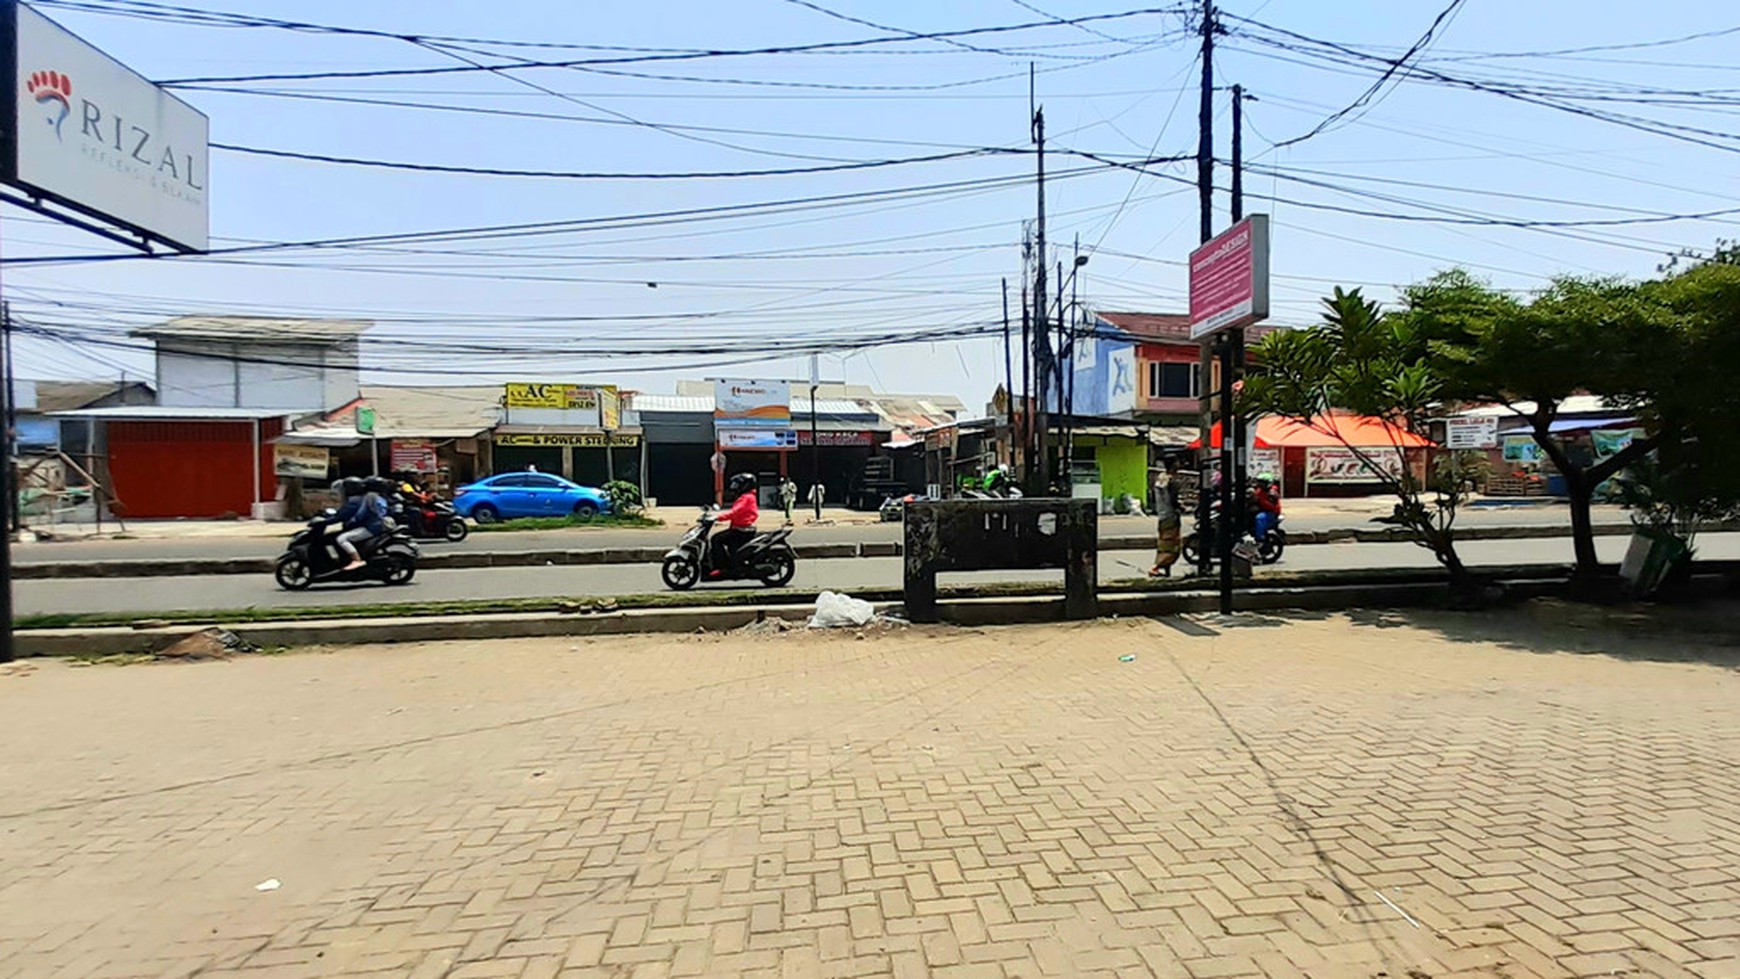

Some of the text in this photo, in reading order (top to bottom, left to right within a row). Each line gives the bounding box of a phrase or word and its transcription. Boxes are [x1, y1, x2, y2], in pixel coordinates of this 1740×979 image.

[81, 98, 202, 191] RIZAL
[525, 384, 553, 399] AC
[501, 435, 516, 444] AC
[544, 435, 581, 444] POWER
[585, 435, 634, 445] STEEING
